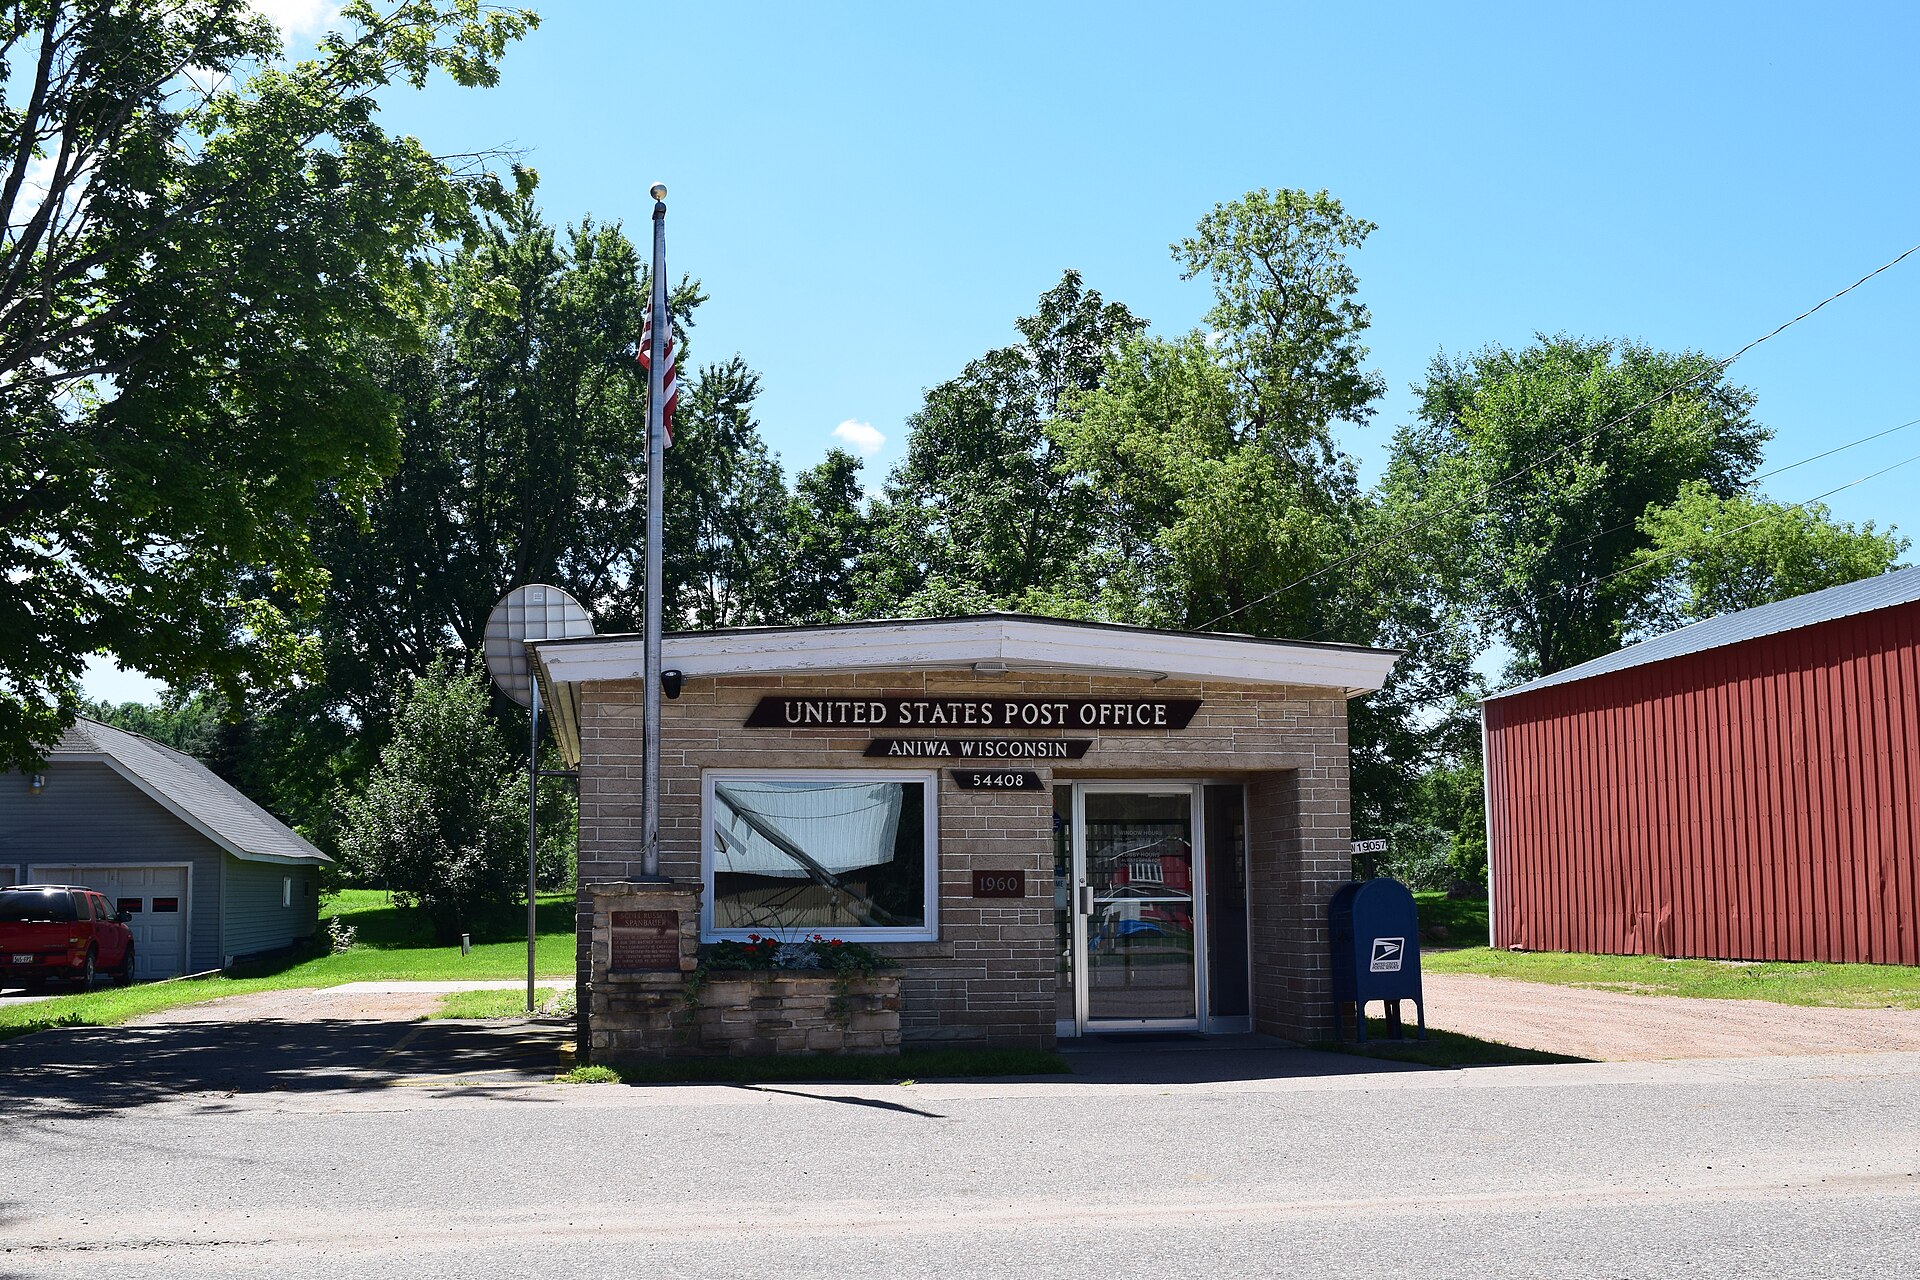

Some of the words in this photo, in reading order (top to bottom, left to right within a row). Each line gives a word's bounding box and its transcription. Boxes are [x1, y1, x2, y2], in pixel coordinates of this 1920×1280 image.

[785, 702, 886, 723] UNITED
[900, 703, 992, 724] STATES
[1005, 704, 1068, 724] POST
[1080, 704, 1166, 724] OFFICE
[888, 741, 952, 756] ANIWA
[958, 742, 1067, 757] WISCONSIN
[973, 774, 1024, 787] 54408
[979, 877, 1018, 891] 1960
